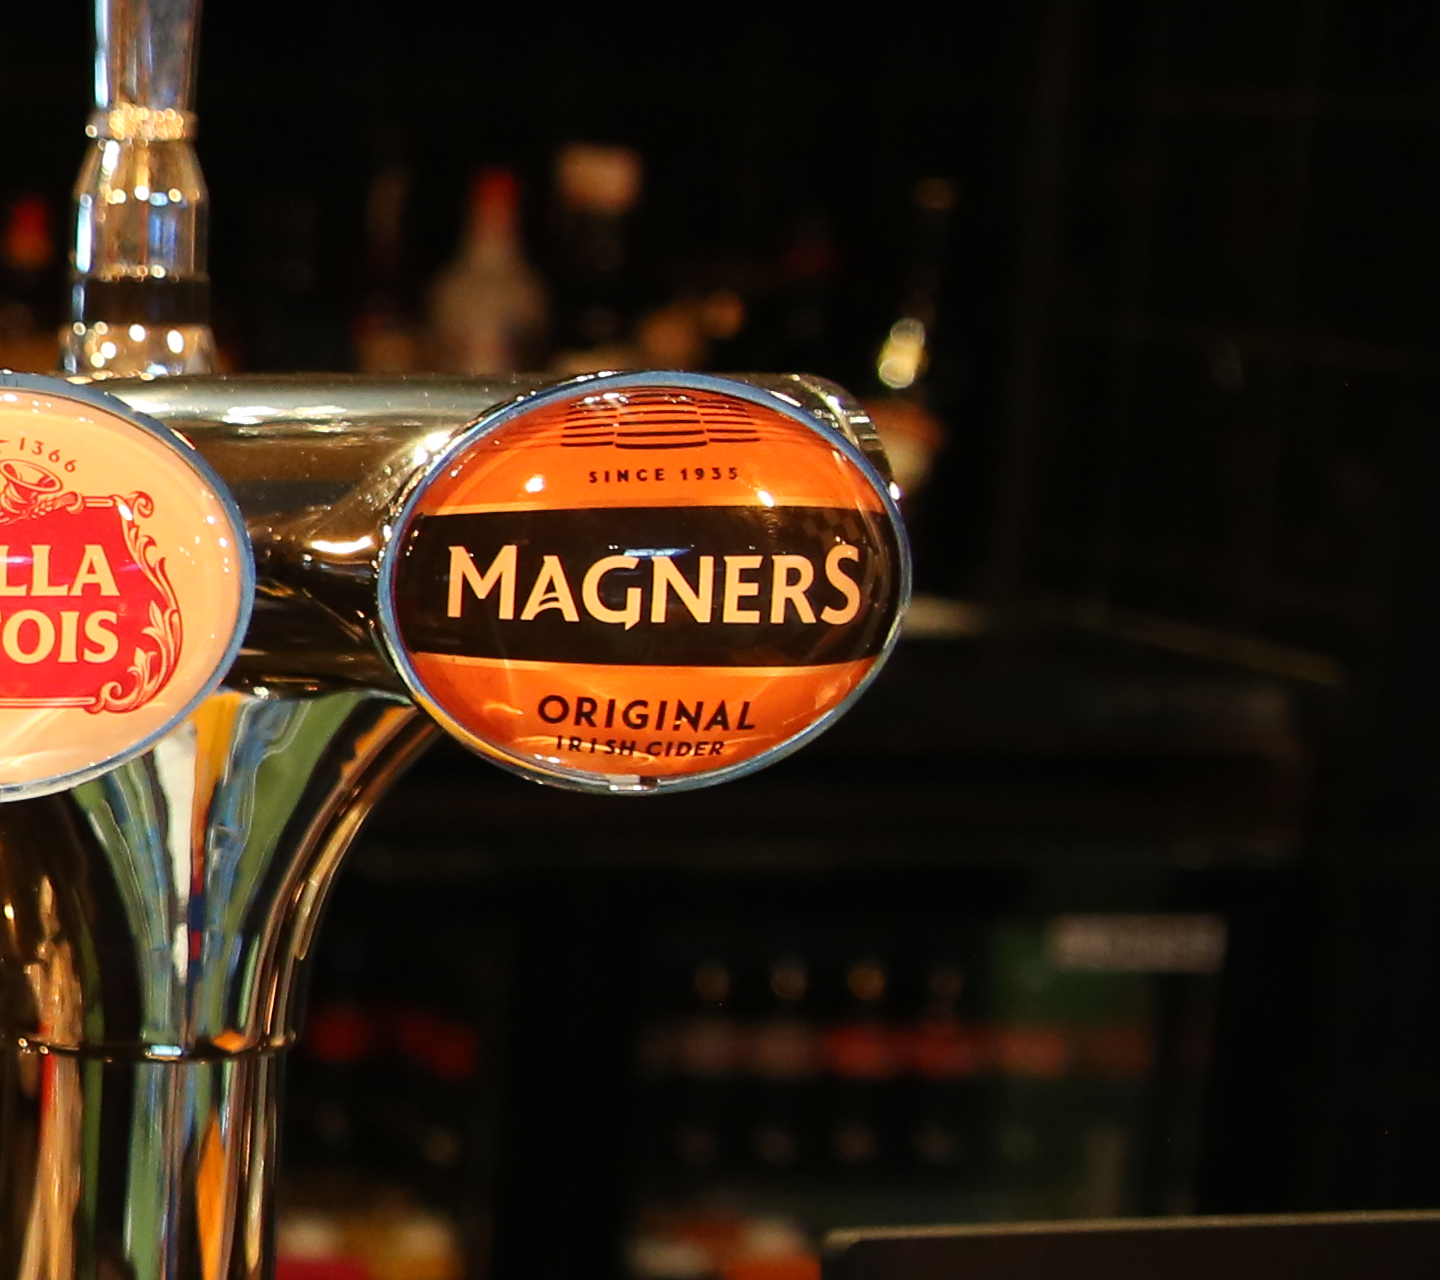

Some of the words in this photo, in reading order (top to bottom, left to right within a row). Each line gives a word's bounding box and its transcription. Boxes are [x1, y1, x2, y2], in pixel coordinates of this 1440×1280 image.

[18, 436, 78, 475] 1366
[588, 468, 666, 484] SINCE
[679, 466, 739, 481] 1935
[446, 543, 861, 630] MAGNERS
[537, 693, 757, 731] ORIGINAL
[556, 734, 637, 757] IRISH
[645, 739, 725, 758] CIDER
